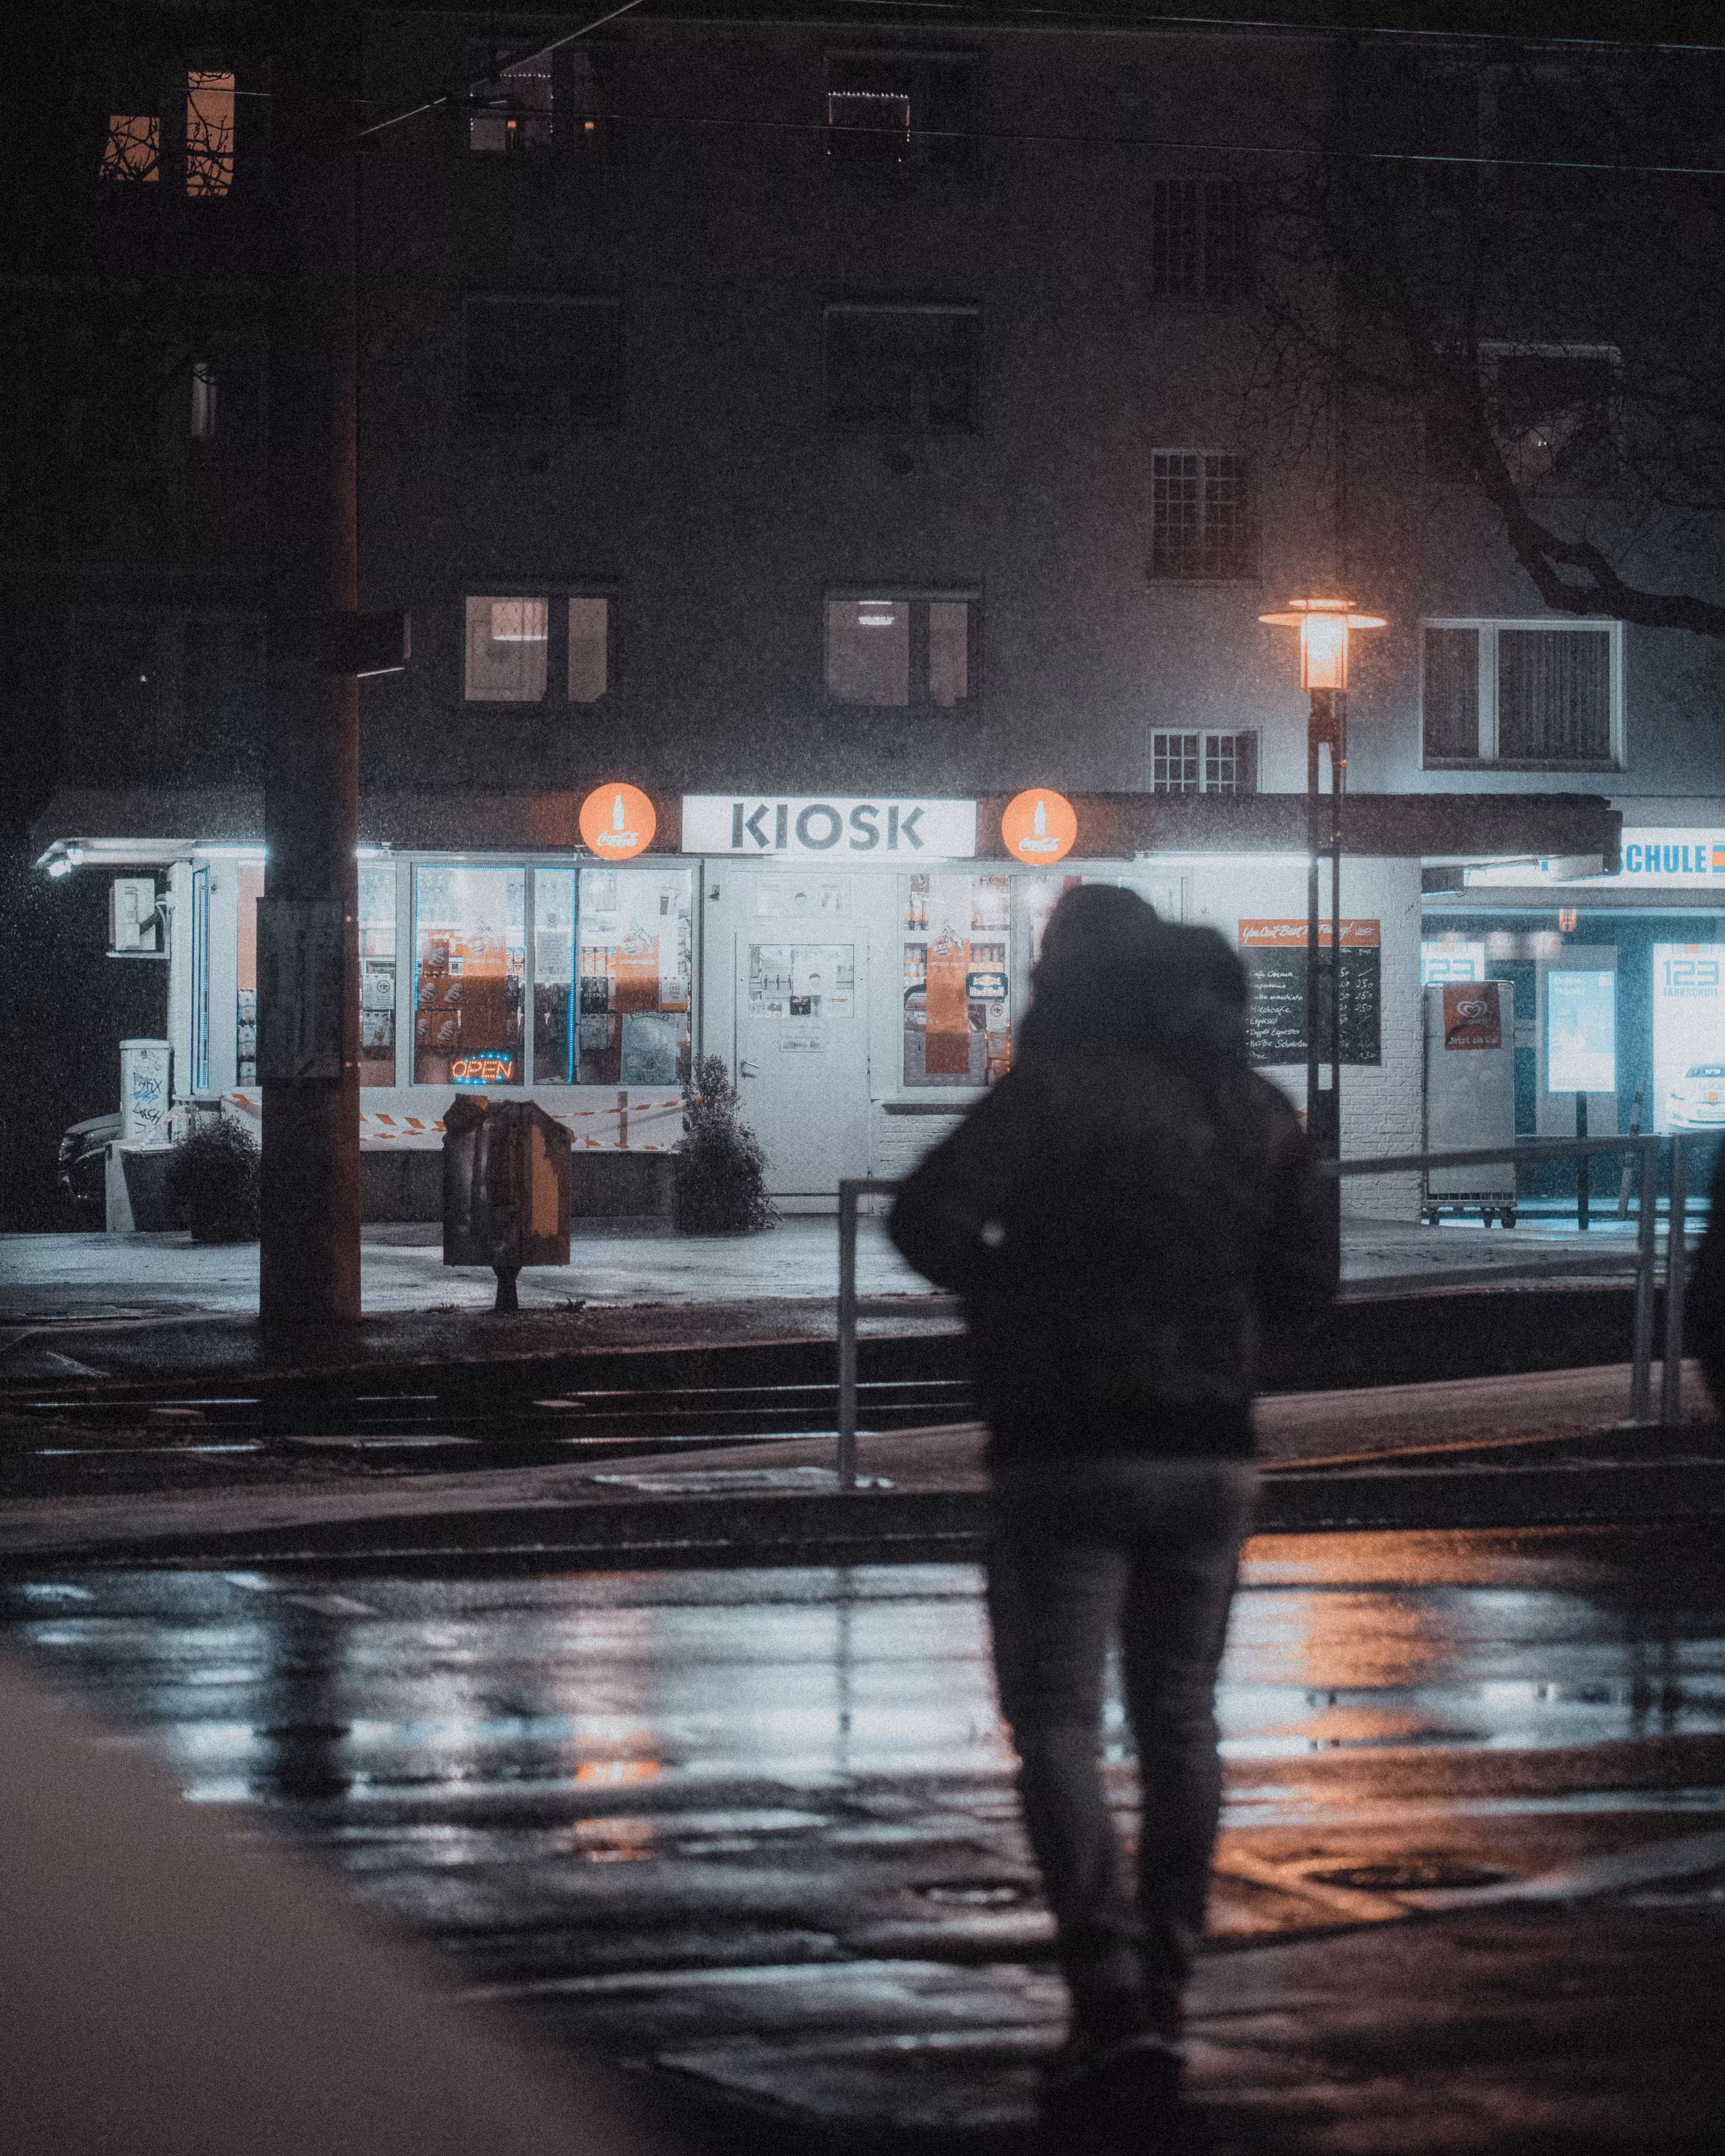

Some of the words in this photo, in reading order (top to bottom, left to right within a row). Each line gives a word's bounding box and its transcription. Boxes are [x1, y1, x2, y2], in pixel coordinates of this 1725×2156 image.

[731, 802, 925, 851] KIOSK
[1663, 960, 1719, 986] 123
[969, 986, 987, 996] Red
[1664, 987, 1719, 997] FAHRSCHULE
[452, 1060, 512, 1078] OPEN
